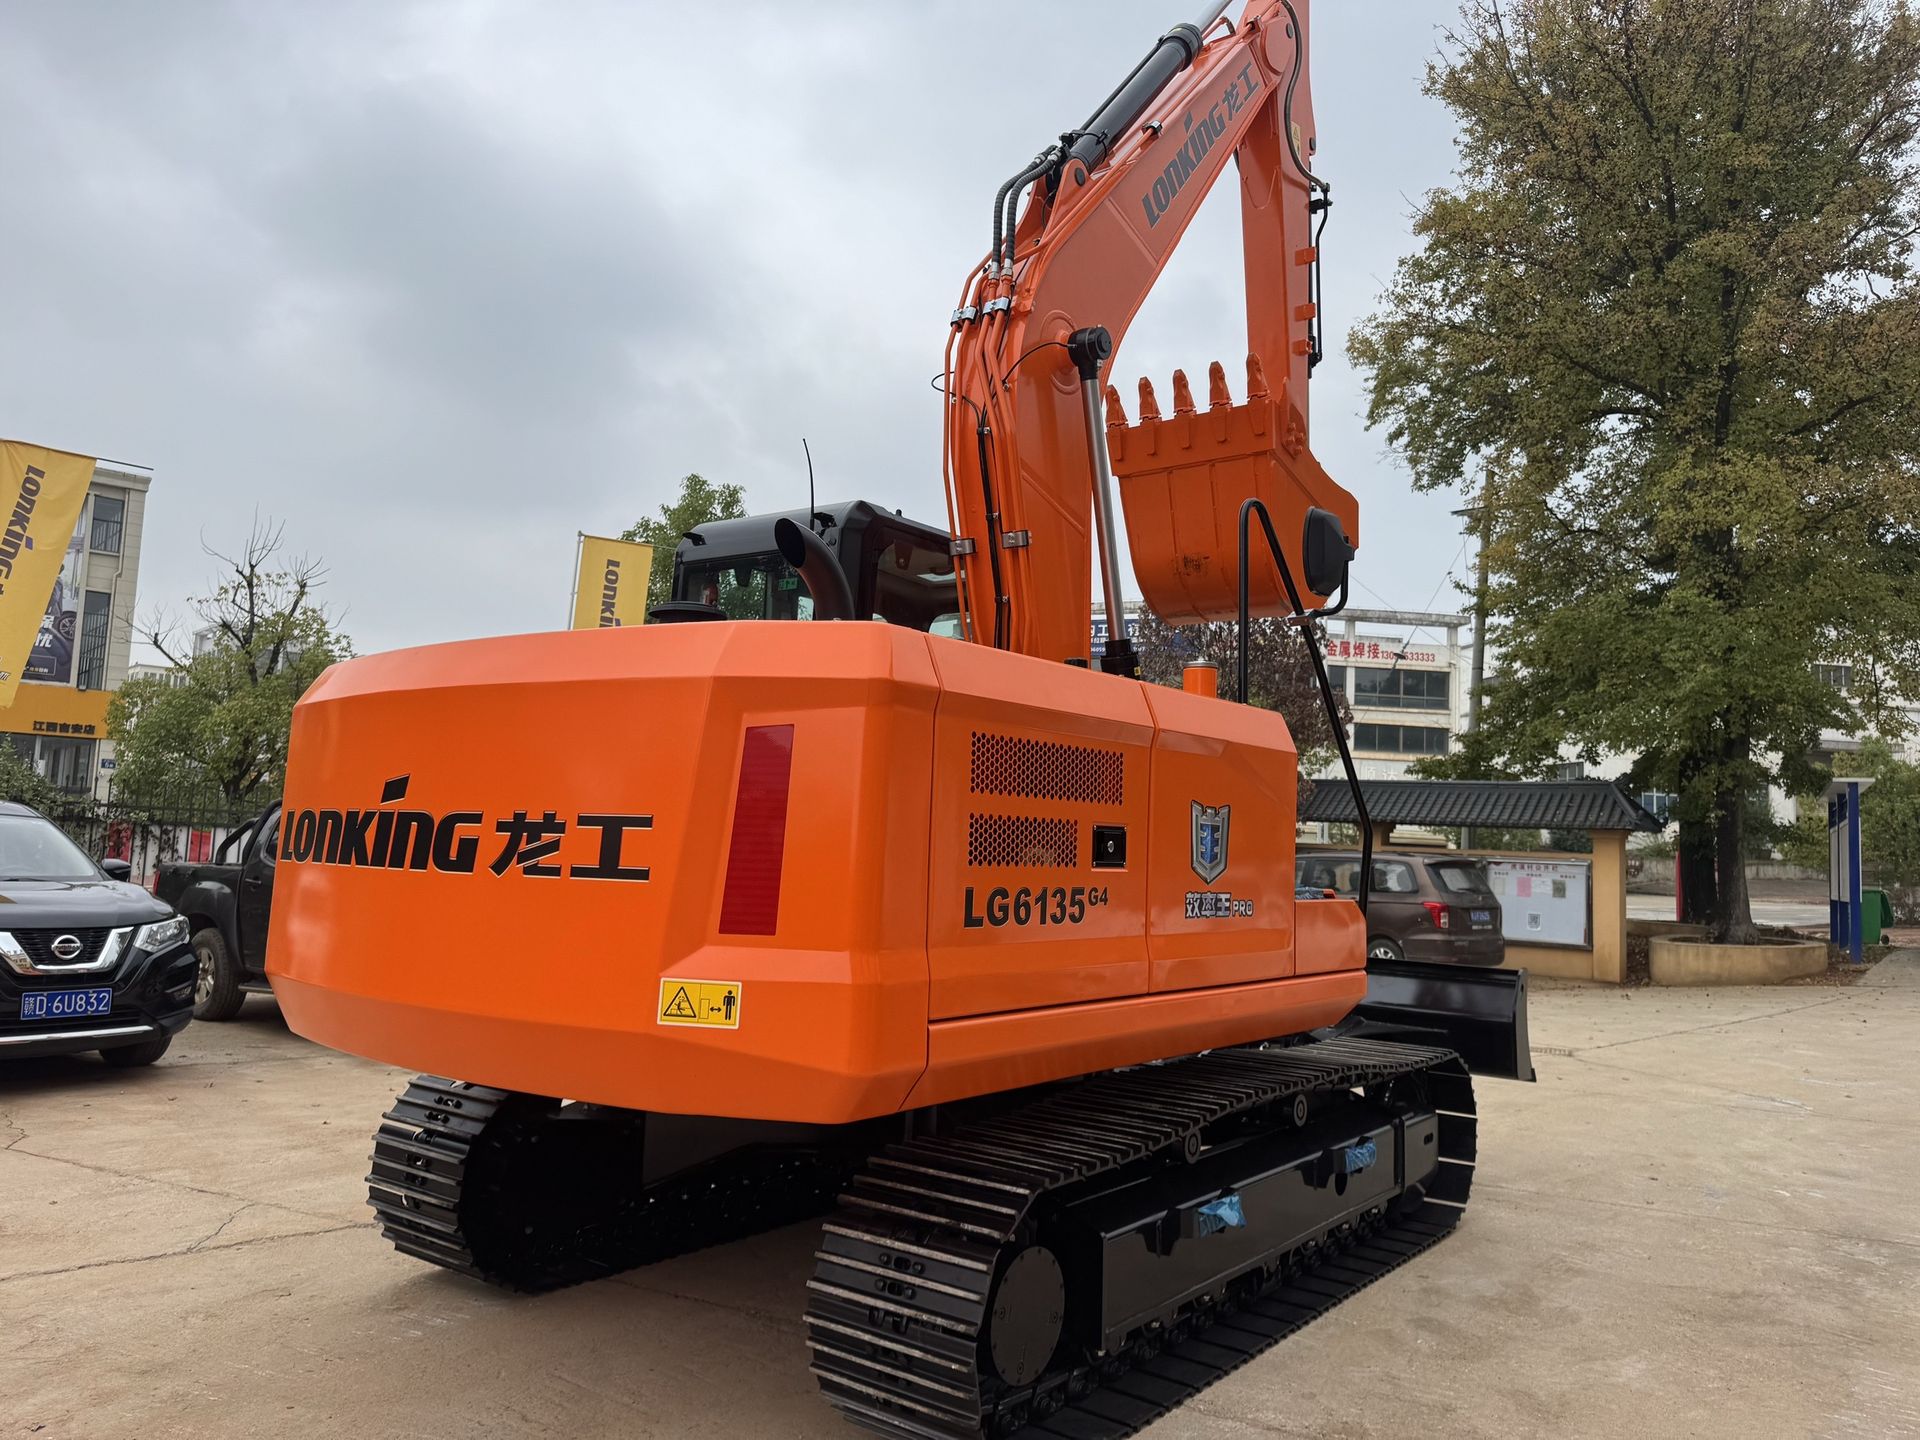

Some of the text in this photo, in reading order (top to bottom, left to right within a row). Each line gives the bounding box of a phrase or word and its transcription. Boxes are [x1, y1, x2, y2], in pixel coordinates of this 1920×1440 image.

[1141, 61, 1260, 229] LONKING 龙工
[598, 558, 622, 627] LONKI
[279, 773, 654, 883] LONKING 龙工
[1232, 899, 1254, 917] PRO
